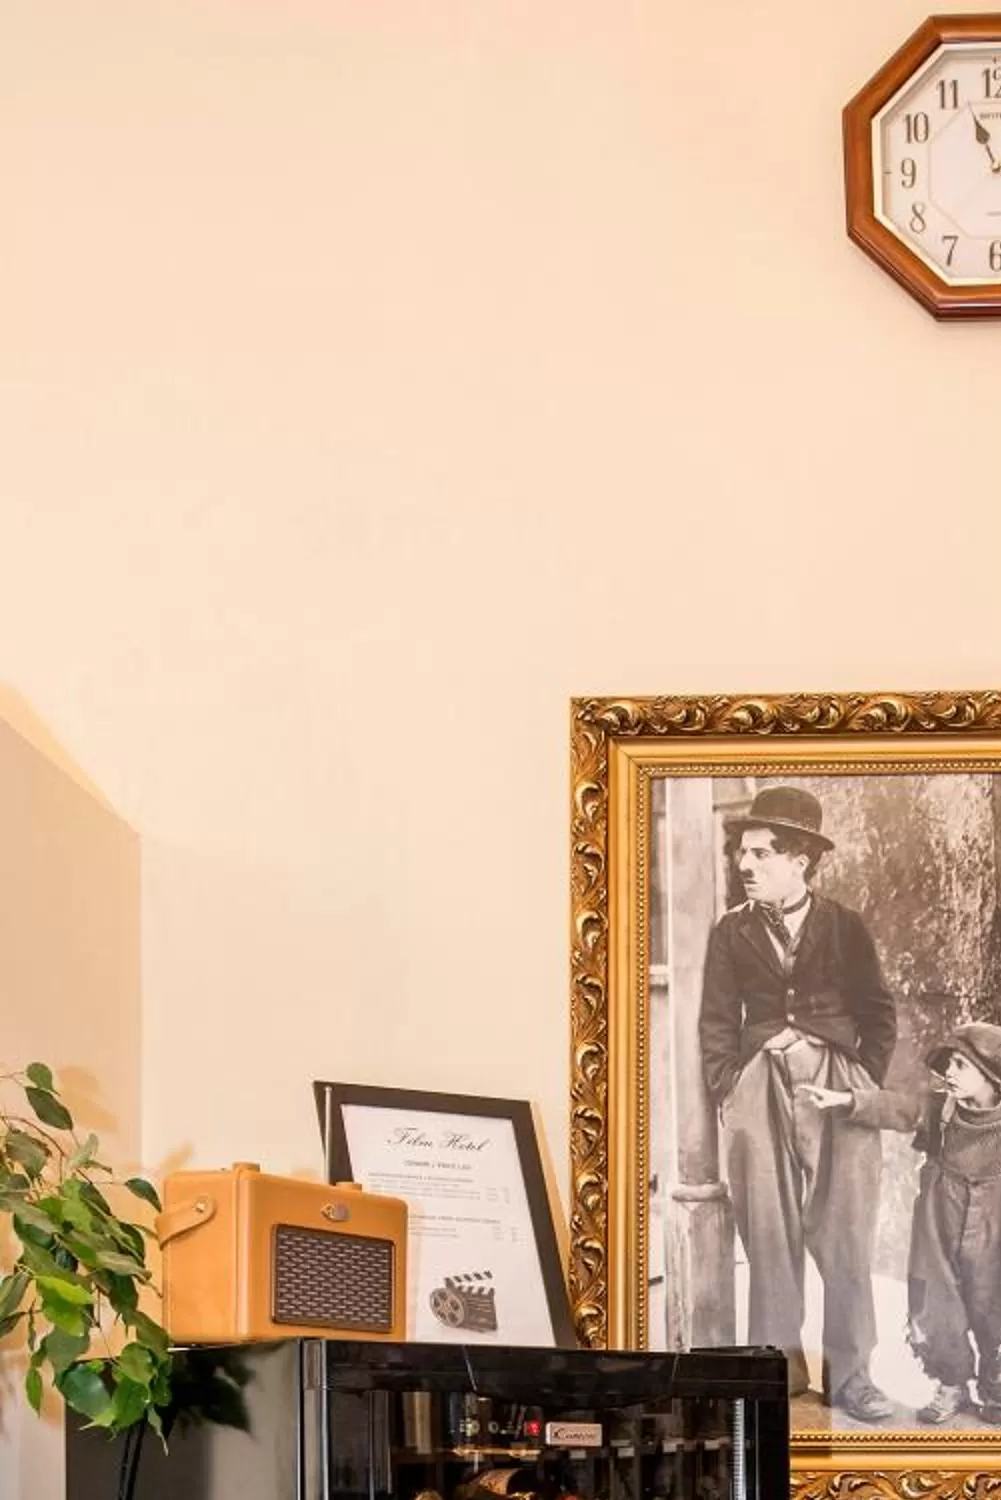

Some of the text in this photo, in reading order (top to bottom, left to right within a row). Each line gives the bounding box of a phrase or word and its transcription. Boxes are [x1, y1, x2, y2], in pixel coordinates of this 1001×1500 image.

[936, 80, 959, 110] 11
[904, 112, 930, 143] 10
[901, 158, 916, 188] 9
[909, 204, 926, 233] 8
[942, 235, 958, 266] 7
[386, 1127, 490, 1150] Film Hotel
